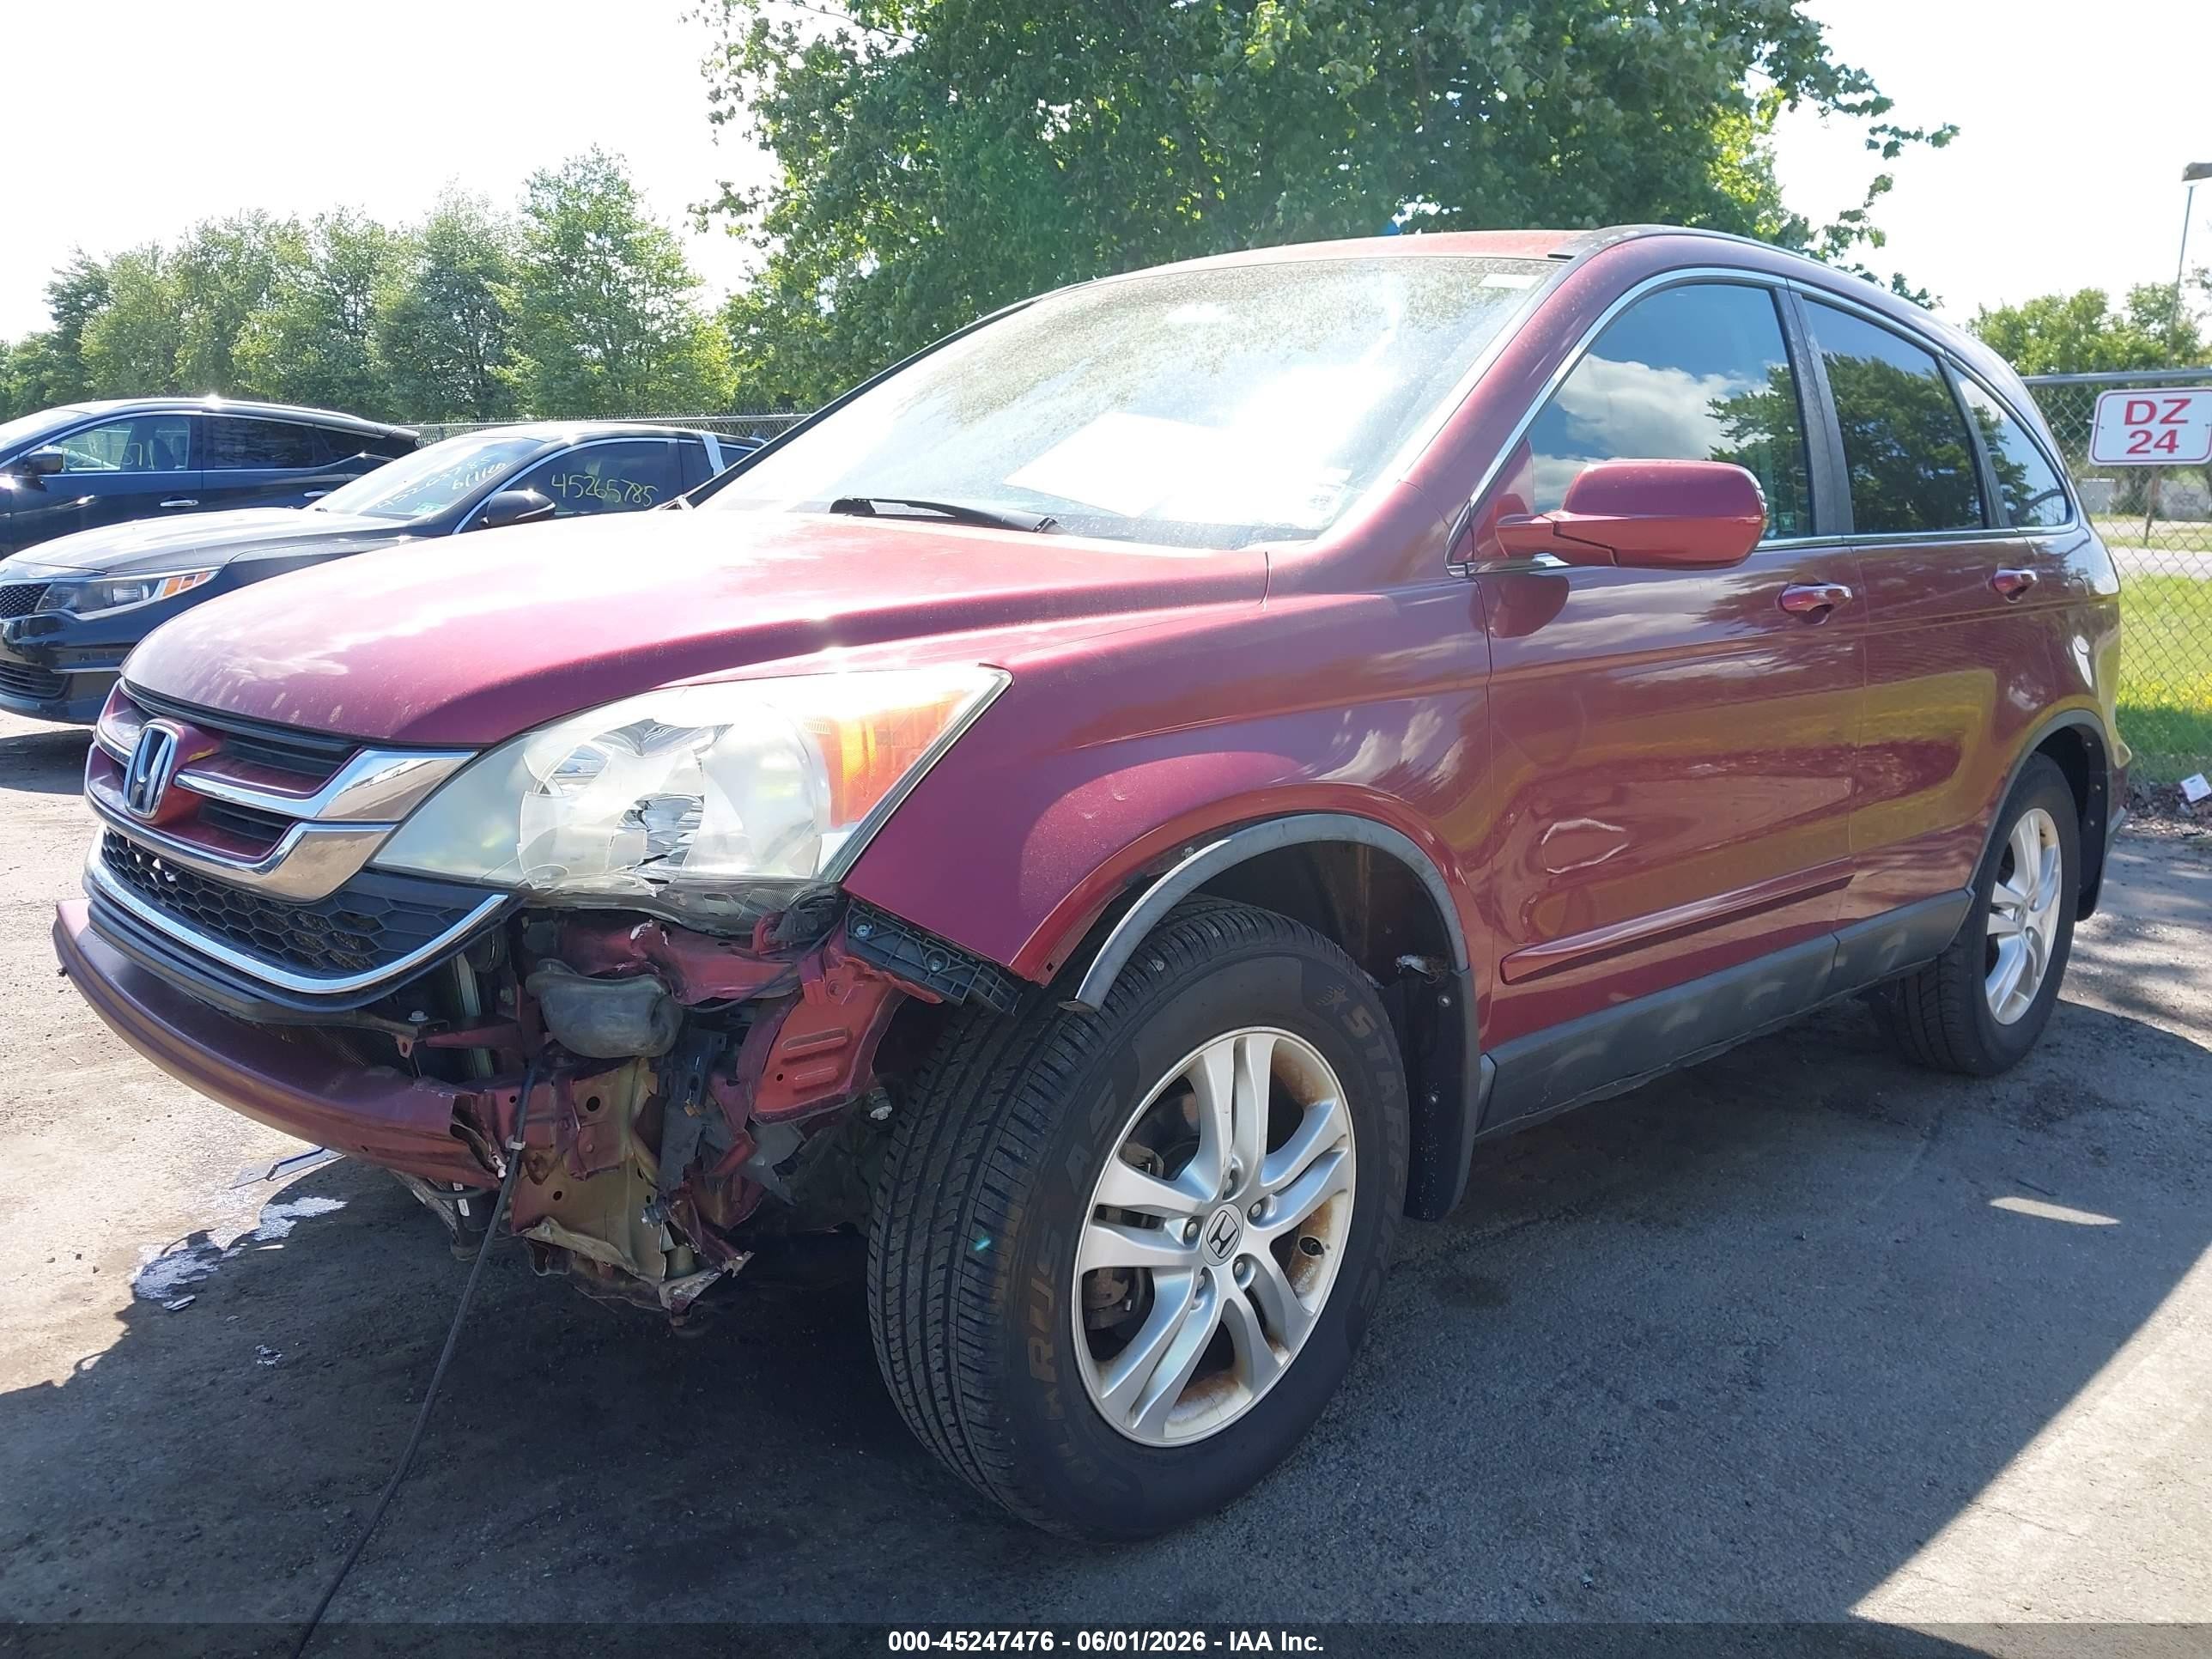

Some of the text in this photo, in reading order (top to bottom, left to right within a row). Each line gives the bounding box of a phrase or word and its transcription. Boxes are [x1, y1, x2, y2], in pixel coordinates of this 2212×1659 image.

[2124, 398, 2192, 426] DZ
[2125, 428, 2180, 454] 24
[551, 473, 659, 507] 45265785
